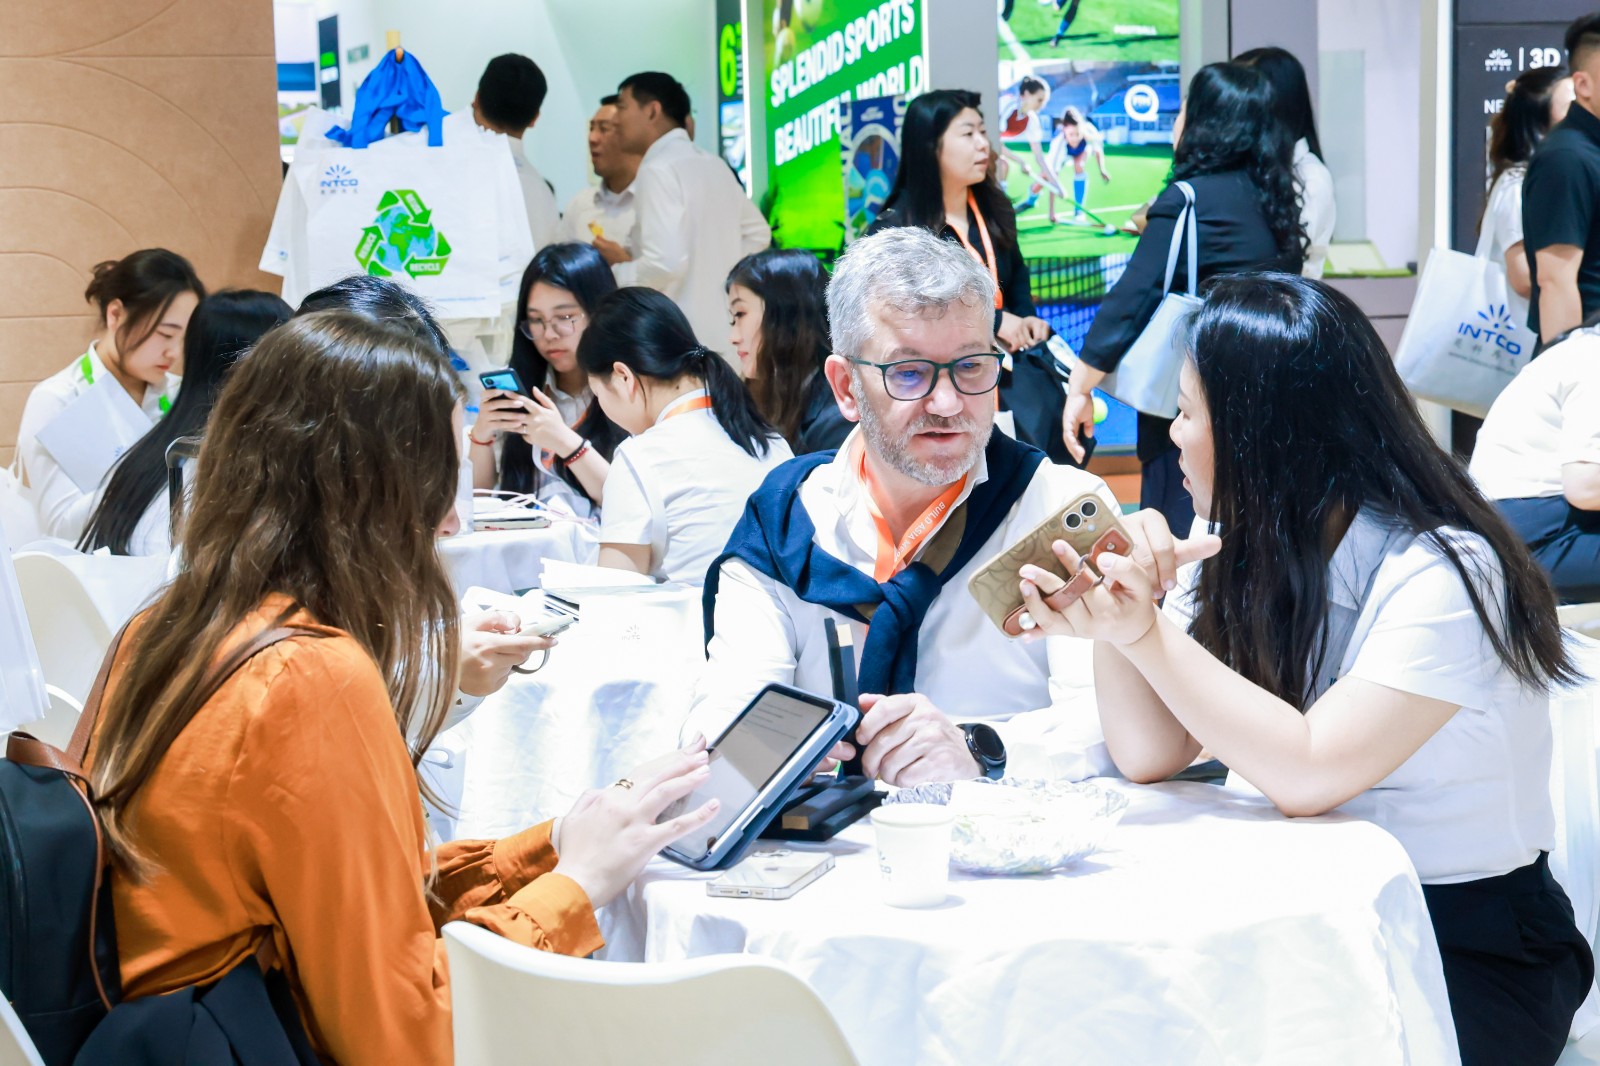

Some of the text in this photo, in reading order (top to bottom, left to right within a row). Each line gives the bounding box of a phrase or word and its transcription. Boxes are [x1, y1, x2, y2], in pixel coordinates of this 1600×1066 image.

[771, 31, 845, 108] SPLENDID
[844, 0, 915, 65] SPORTS
[1529, 47, 1561, 69] 3D
[1458, 322, 1521, 355] INTCO
[924, 501, 946, 525] BUILD
[908, 522, 926, 540] ASIA
